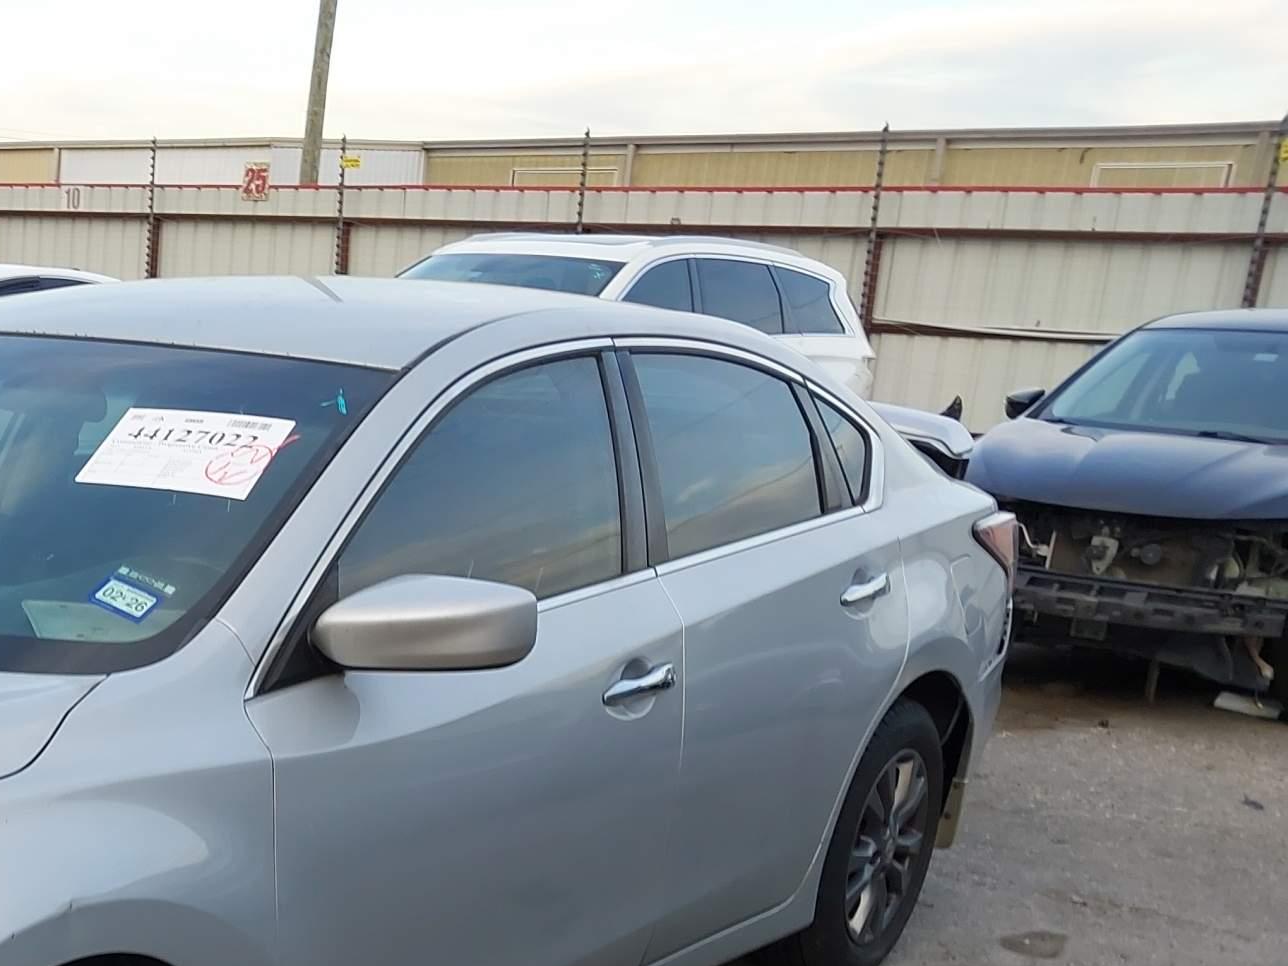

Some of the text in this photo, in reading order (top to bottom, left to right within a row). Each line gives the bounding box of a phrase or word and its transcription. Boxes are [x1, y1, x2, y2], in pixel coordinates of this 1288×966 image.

[243, 167, 268, 194] 25
[64, 187, 81, 210] 10
[128, 427, 259, 449] 44127022
